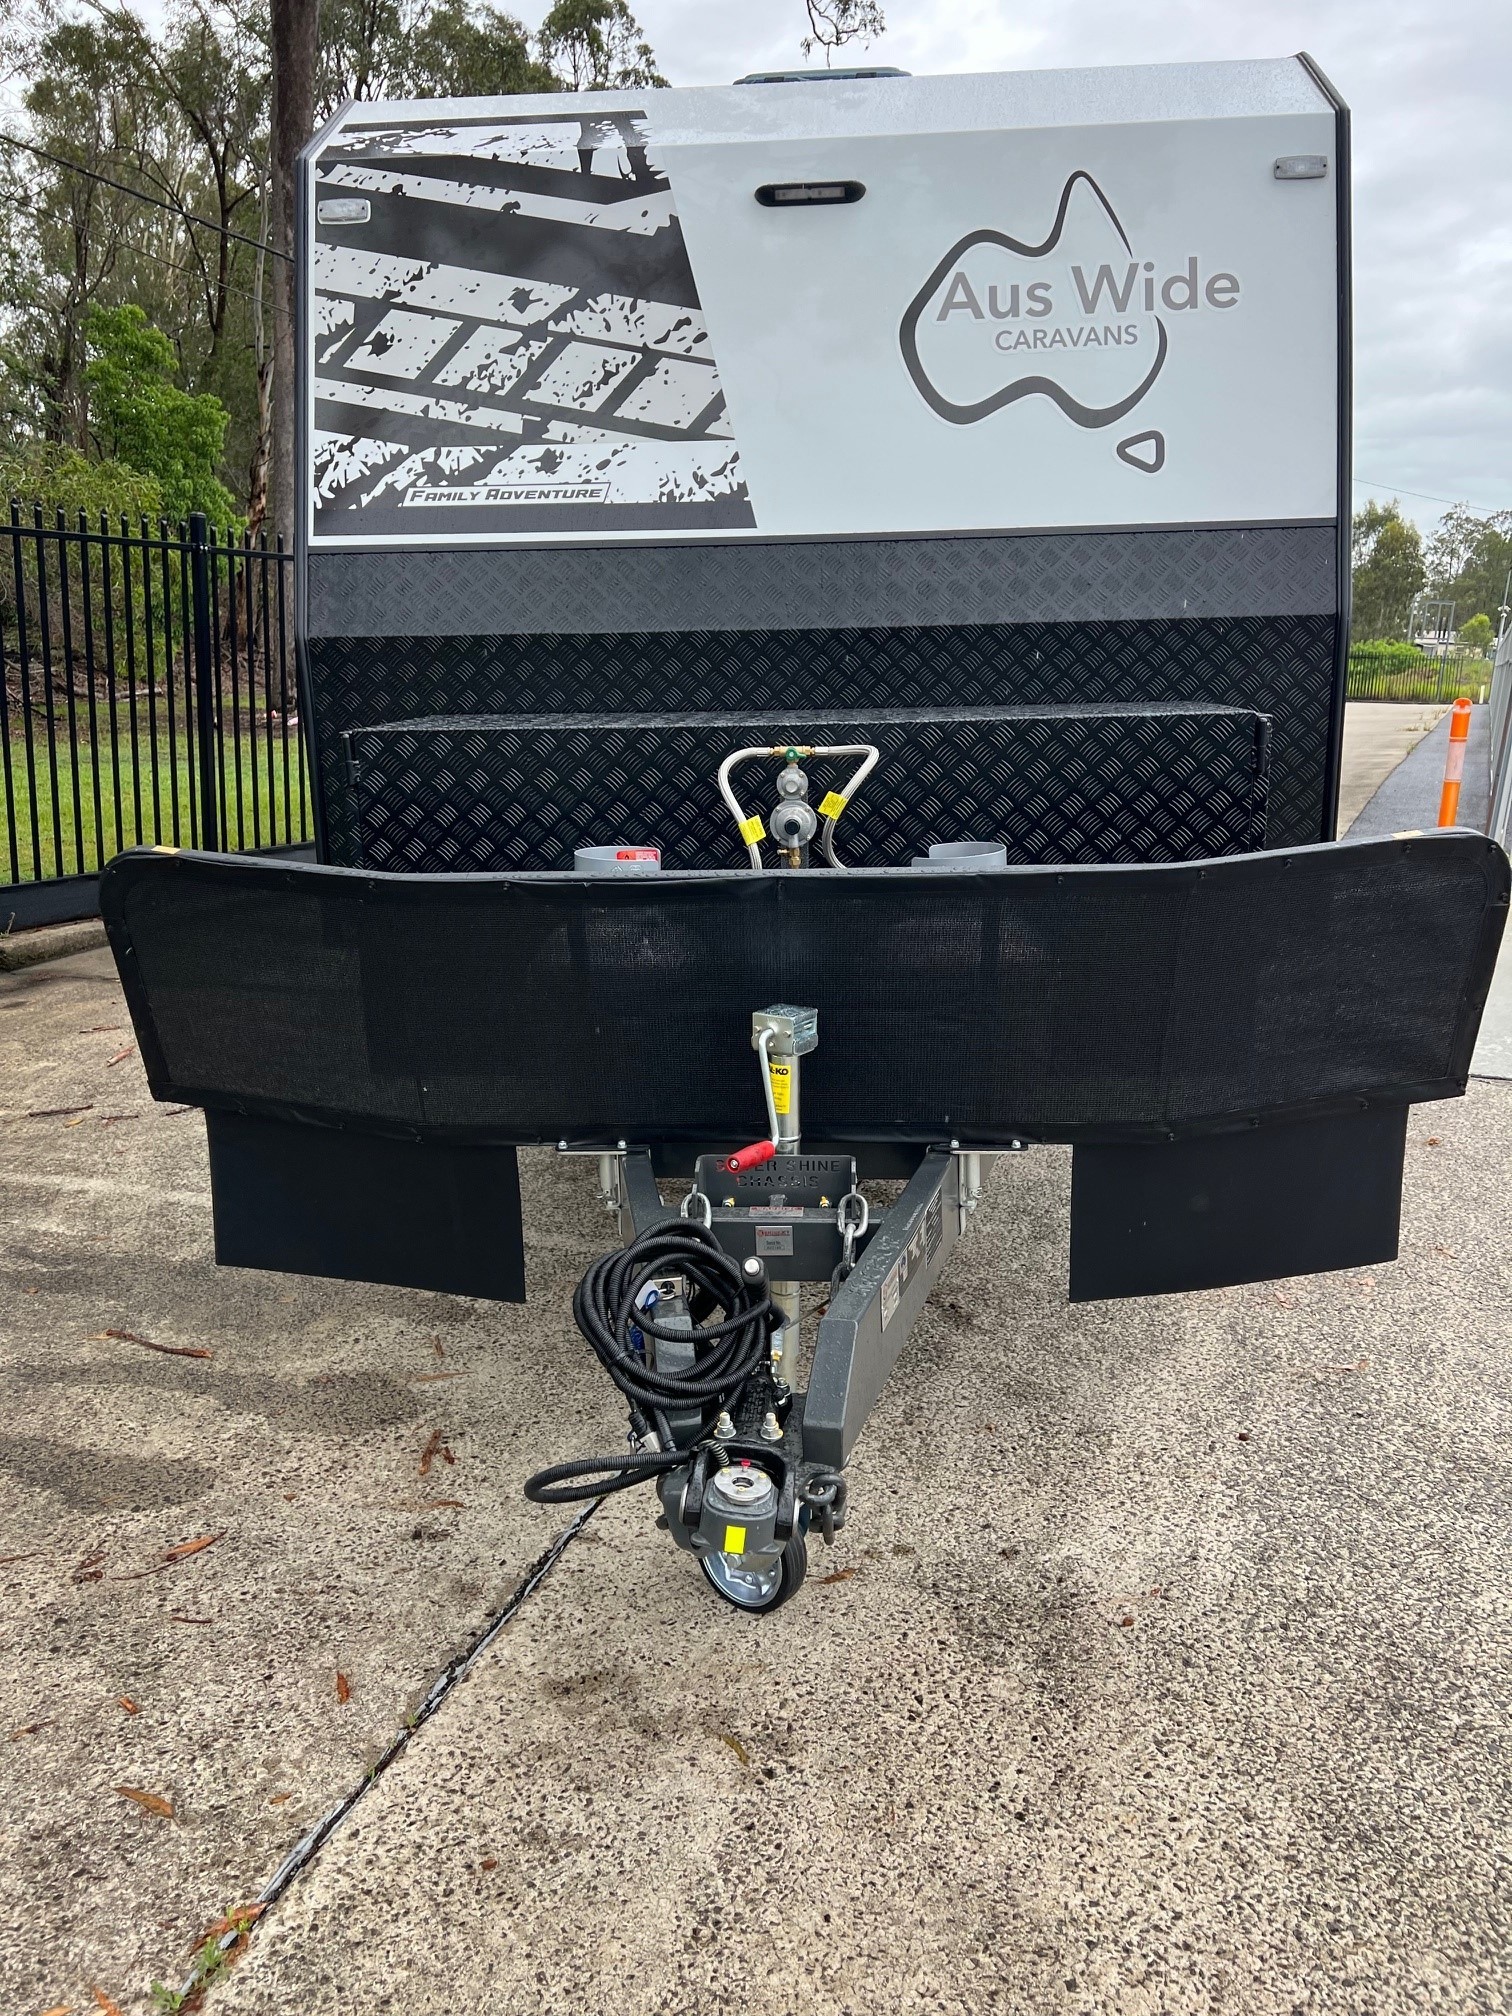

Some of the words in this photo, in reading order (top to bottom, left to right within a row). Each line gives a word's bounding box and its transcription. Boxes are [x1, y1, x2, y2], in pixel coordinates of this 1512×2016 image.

[936, 270, 1054, 322] Aus
[1070, 256, 1241, 315] Wide
[994, 324, 1139, 351] CARAVANS
[409, 490, 482, 502] FAMILY
[485, 488, 604, 501] ADVENTURE
[716, 1159, 777, 1172] SER
[786, 1159, 841, 1172] SHINE
[736, 1175, 819, 1188] CHASSIS
